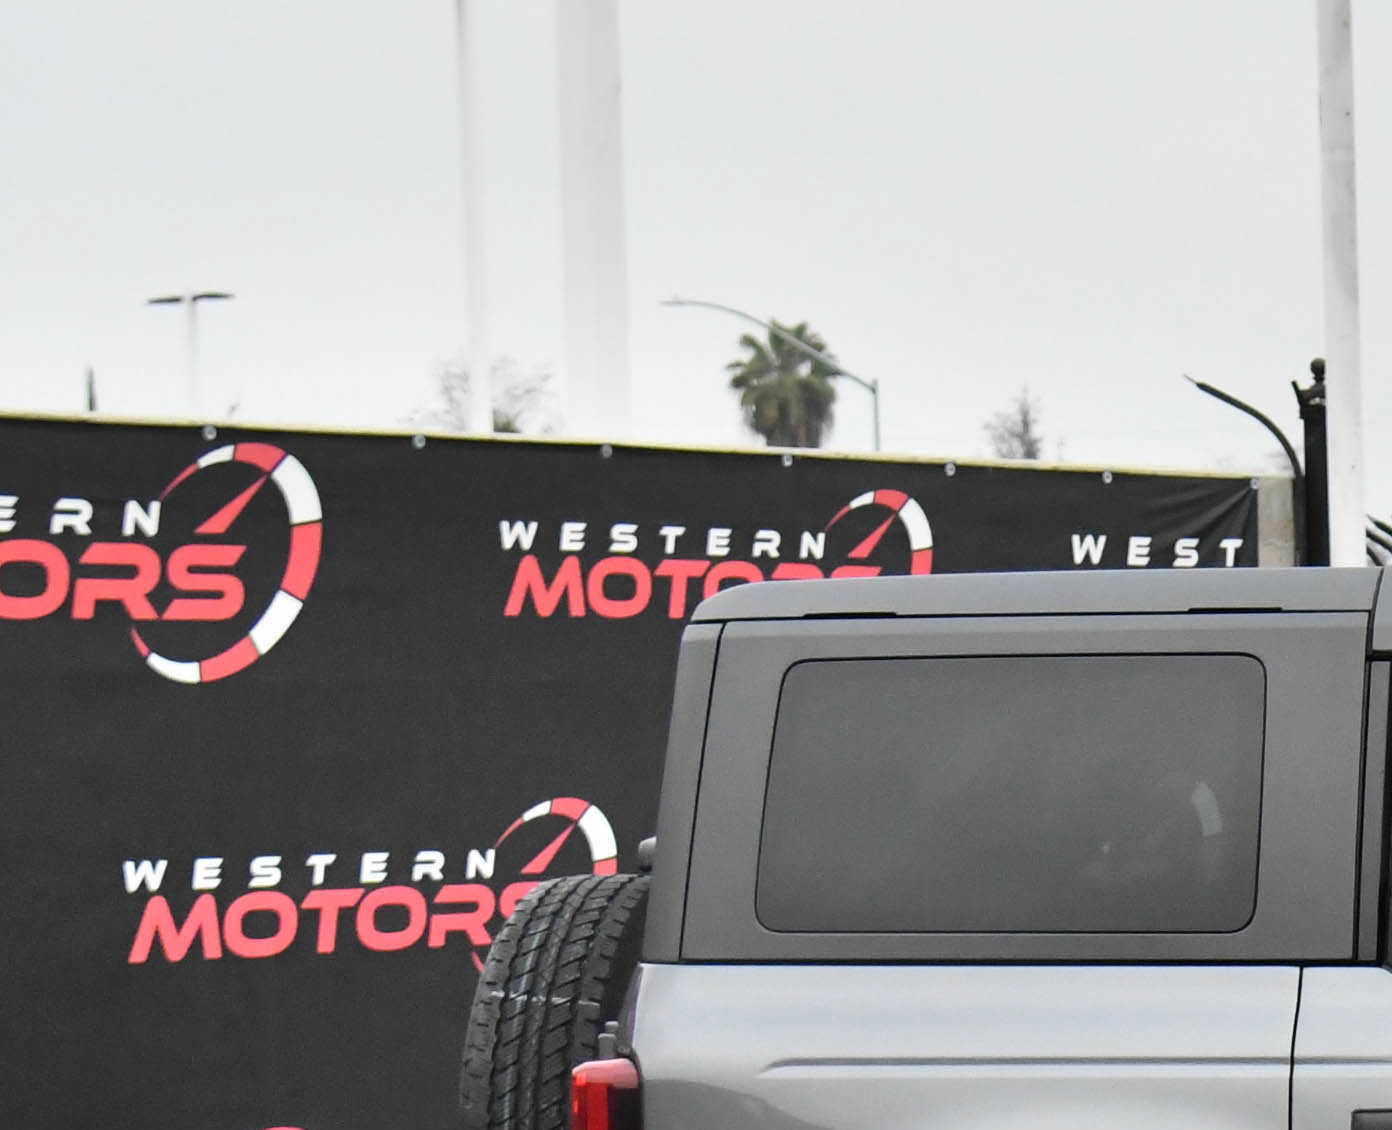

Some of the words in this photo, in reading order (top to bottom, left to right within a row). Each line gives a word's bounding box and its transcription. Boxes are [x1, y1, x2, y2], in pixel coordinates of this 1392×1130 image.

[500, 520, 826, 559] WESTERN
[1071, 534, 1244, 567] WEST
[0, 539, 247, 621] ORS
[503, 554, 882, 619] MOT
[123, 848, 496, 893] WESTERN
